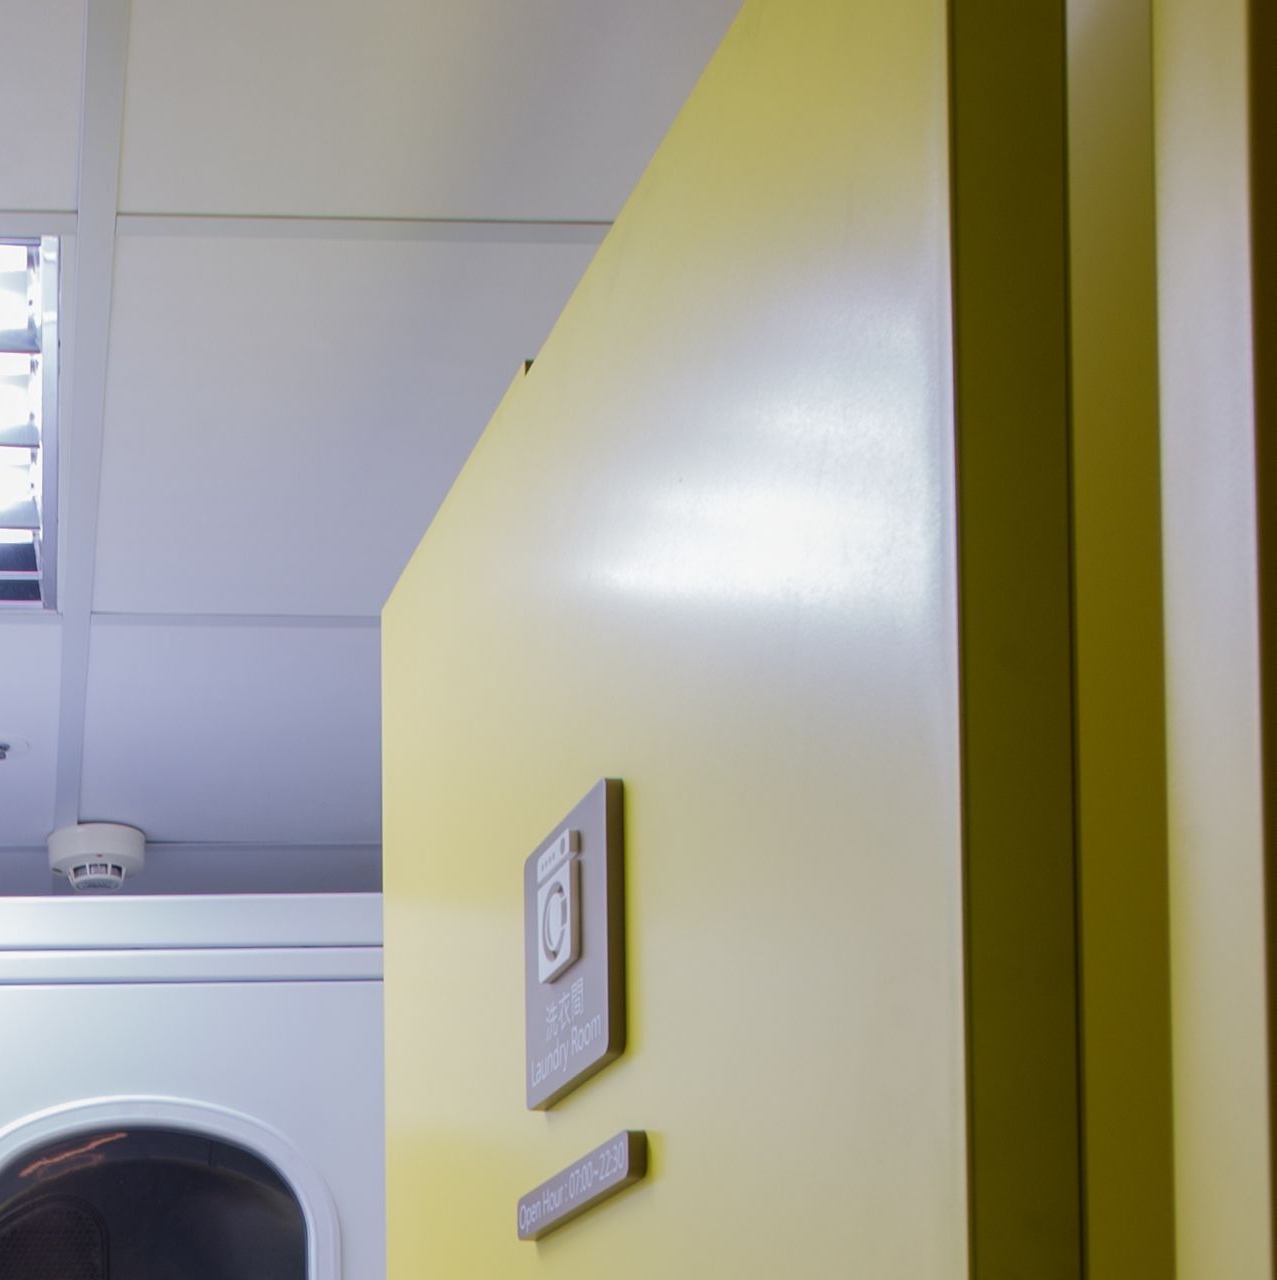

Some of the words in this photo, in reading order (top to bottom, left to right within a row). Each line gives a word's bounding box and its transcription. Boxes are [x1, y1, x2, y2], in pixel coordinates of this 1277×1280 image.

[546, 977, 584, 1042] 洗衣間
[531, 1037, 569, 1088] Laundry
[571, 1014, 602, 1056] Room
[519, 1200, 542, 1233] Open
[543, 1185, 564, 1216] Hour
